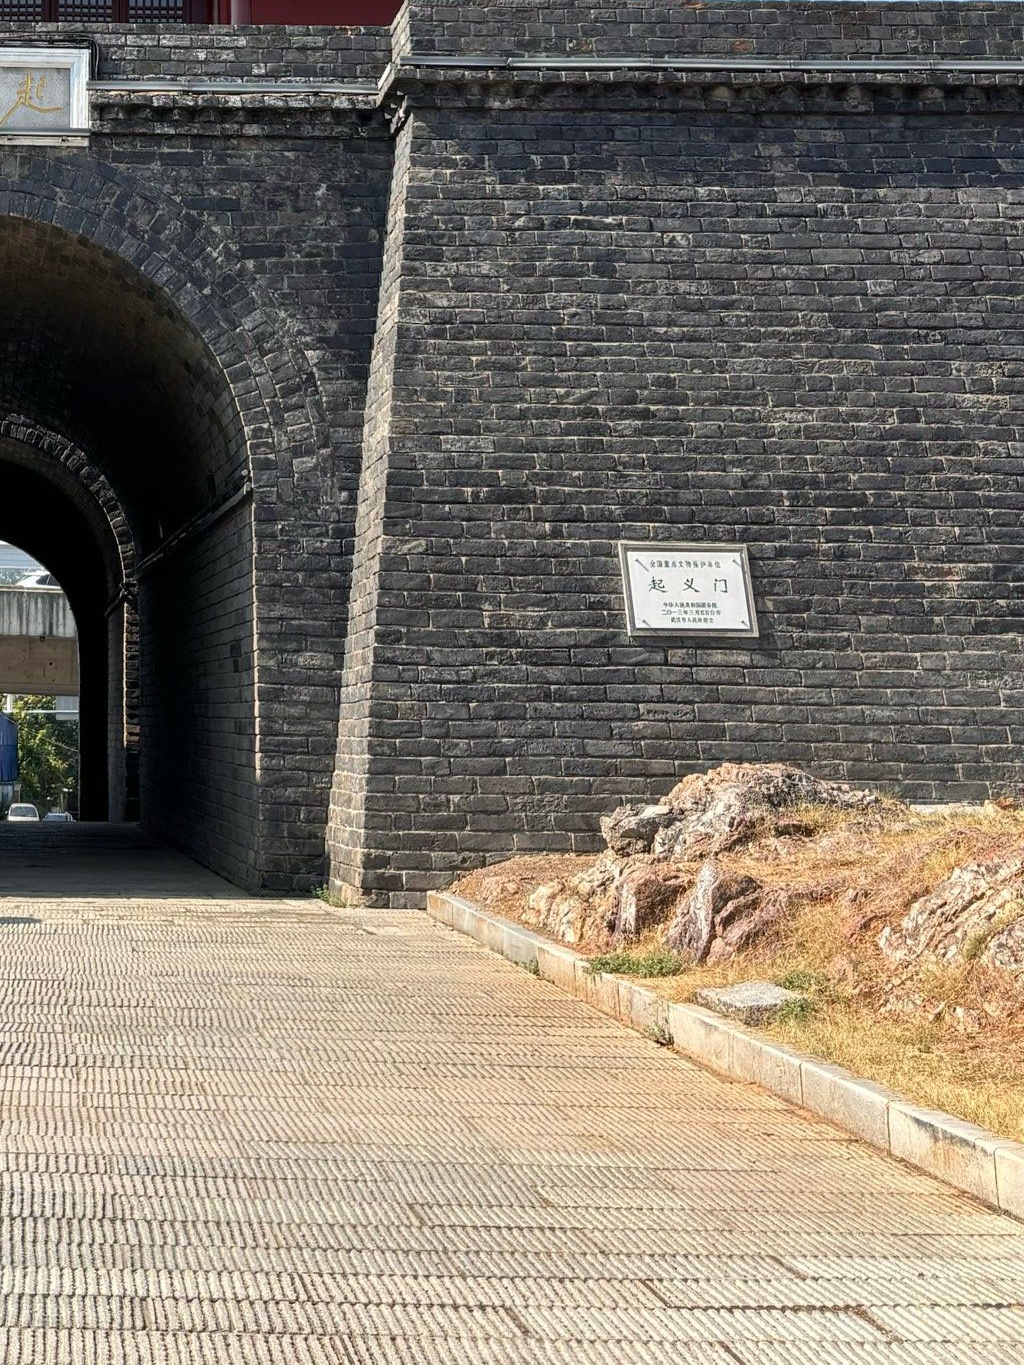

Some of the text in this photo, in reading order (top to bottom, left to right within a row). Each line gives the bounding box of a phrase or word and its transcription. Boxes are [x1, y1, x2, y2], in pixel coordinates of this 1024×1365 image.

[650, 560, 721, 569] 全国重点文物保护单位
[648, 576, 728, 593] 起义门
